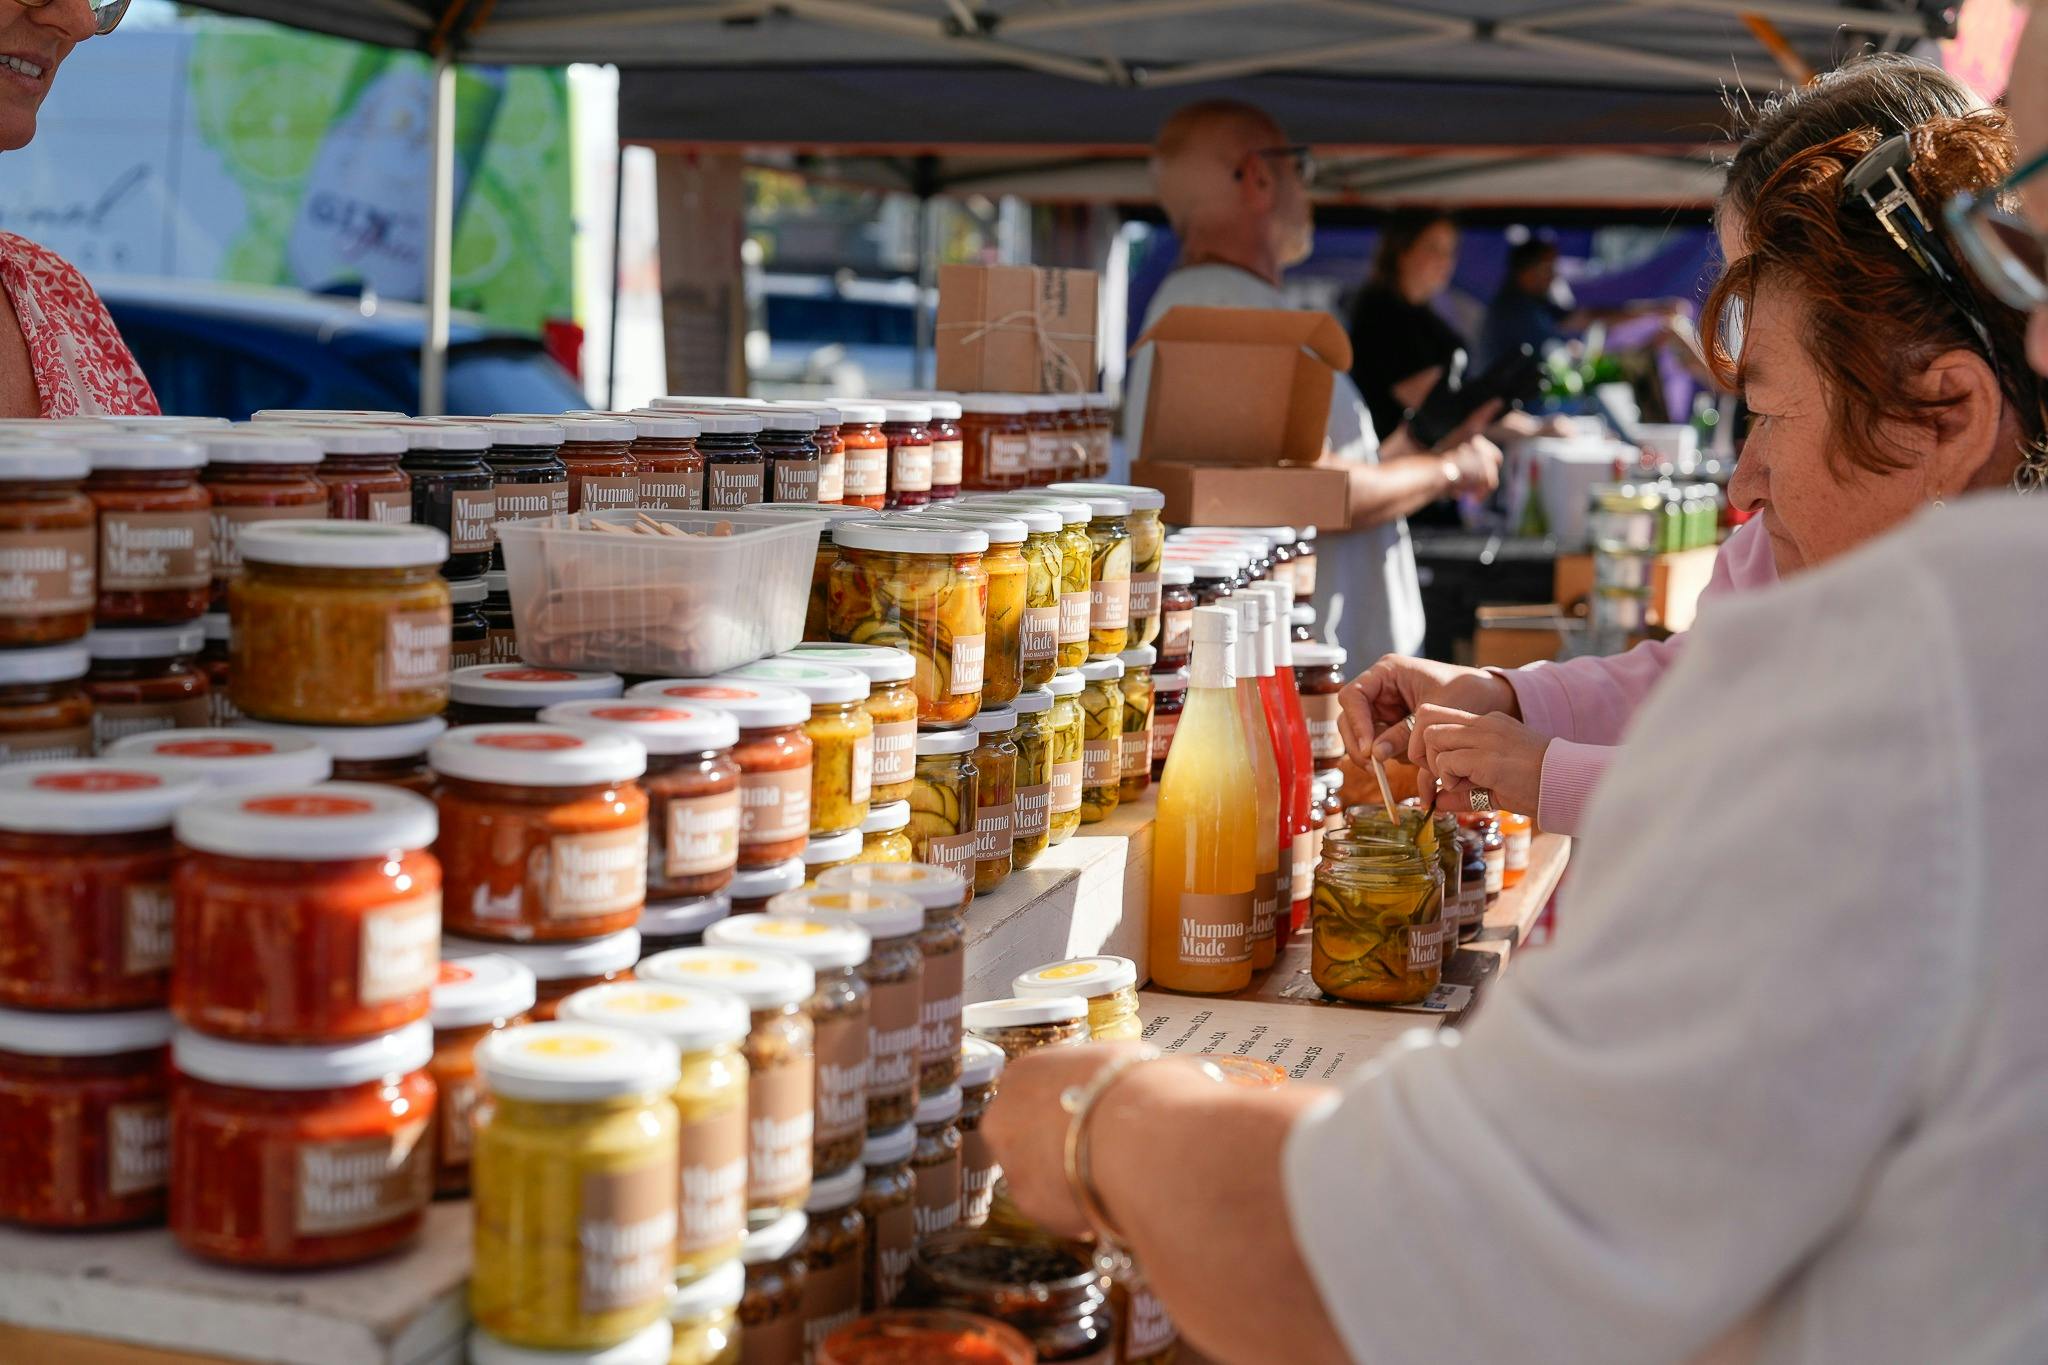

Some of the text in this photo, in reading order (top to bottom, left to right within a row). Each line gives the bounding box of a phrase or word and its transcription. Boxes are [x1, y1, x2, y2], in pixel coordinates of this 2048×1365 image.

[713, 470, 759, 488] Mumma
[583, 483, 634, 503] Mumma
[638, 481, 686, 499] umma
[712, 487, 748, 505] Made
[775, 483, 809, 500] Made
[496, 494, 548, 512] umma
[455, 519, 488, 542] Made
[1130, 593, 1150, 610] ade
[1022, 631, 1052, 650] Made
[875, 751, 901, 772] ade
[1013, 809, 1043, 829] Made
[1181, 918, 1244, 938] Mumma
[1180, 936, 1225, 957] Made
[1409, 946, 1437, 964] Made
[1289, 1045, 1323, 1079] Gift Boxes $25
